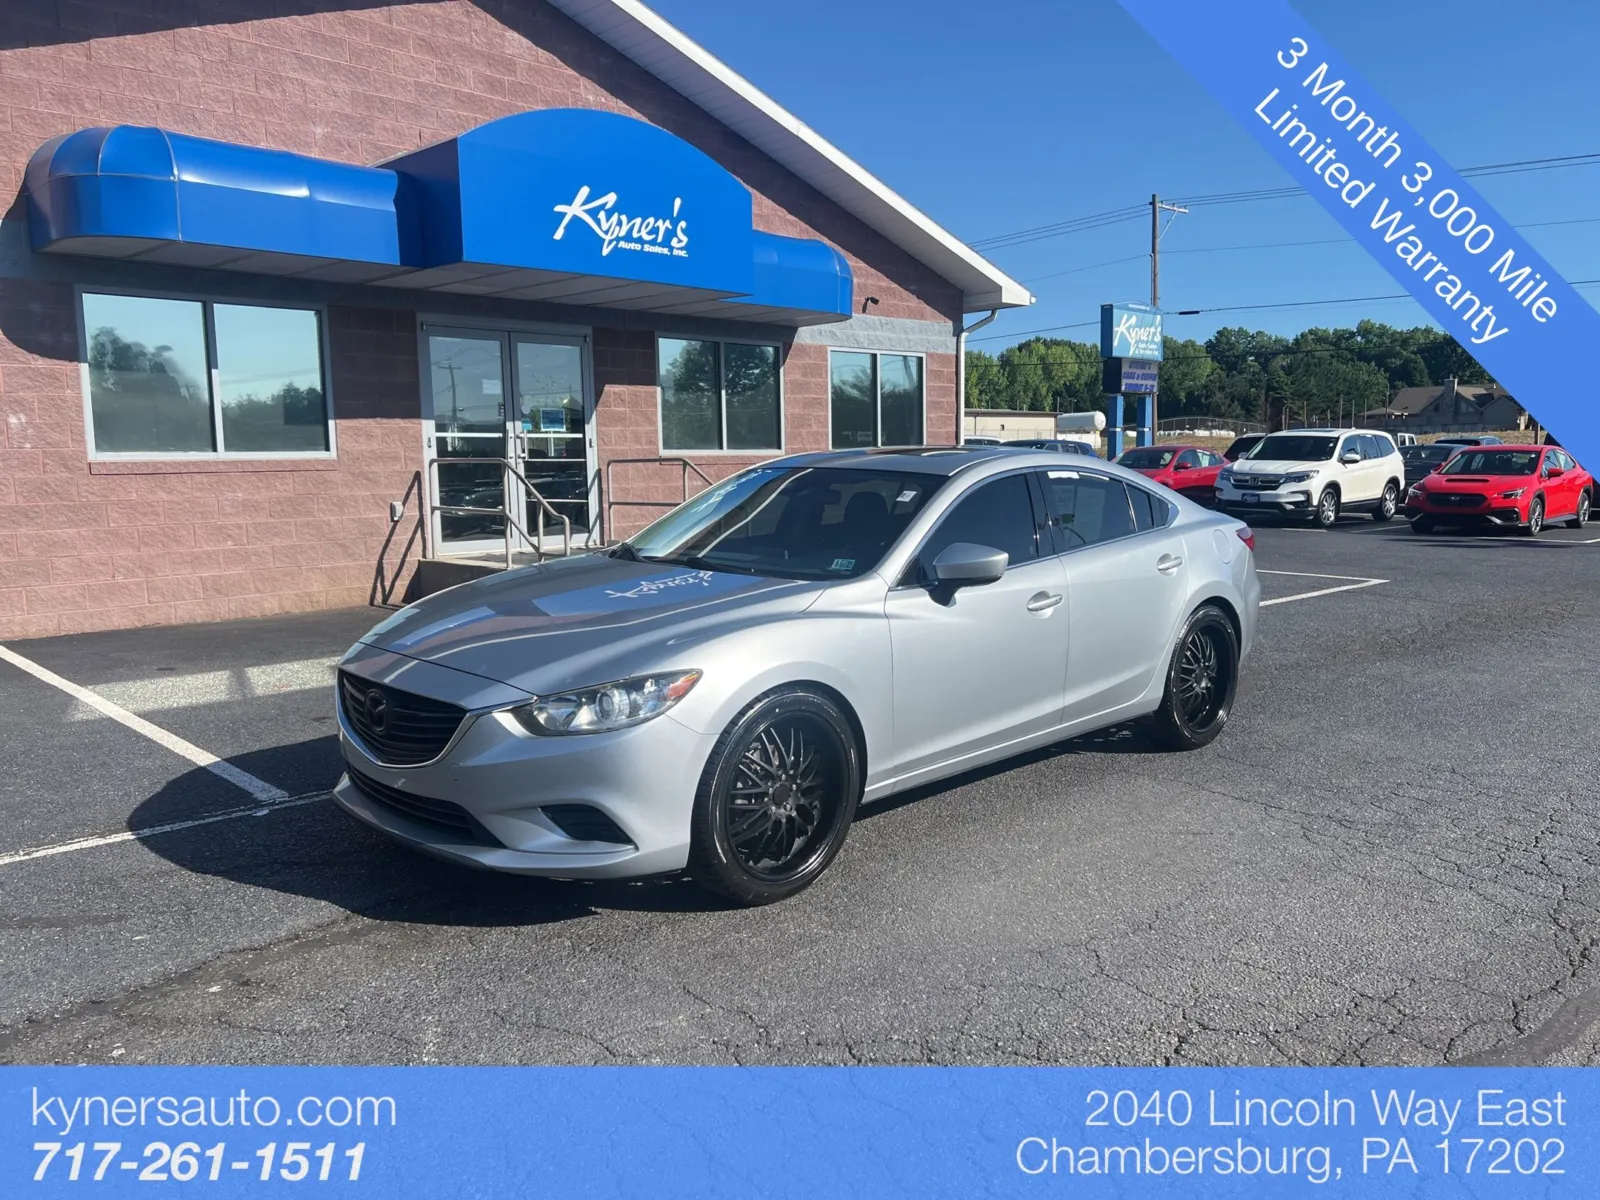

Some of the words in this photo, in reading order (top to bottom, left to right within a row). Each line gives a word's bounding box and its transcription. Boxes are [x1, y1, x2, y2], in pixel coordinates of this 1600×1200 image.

[553, 185, 689, 256] Kyner's
[617, 240, 642, 251] Auto
[643, 243, 671, 256] Sales,
[1113, 313, 1162, 357] Kyner's
